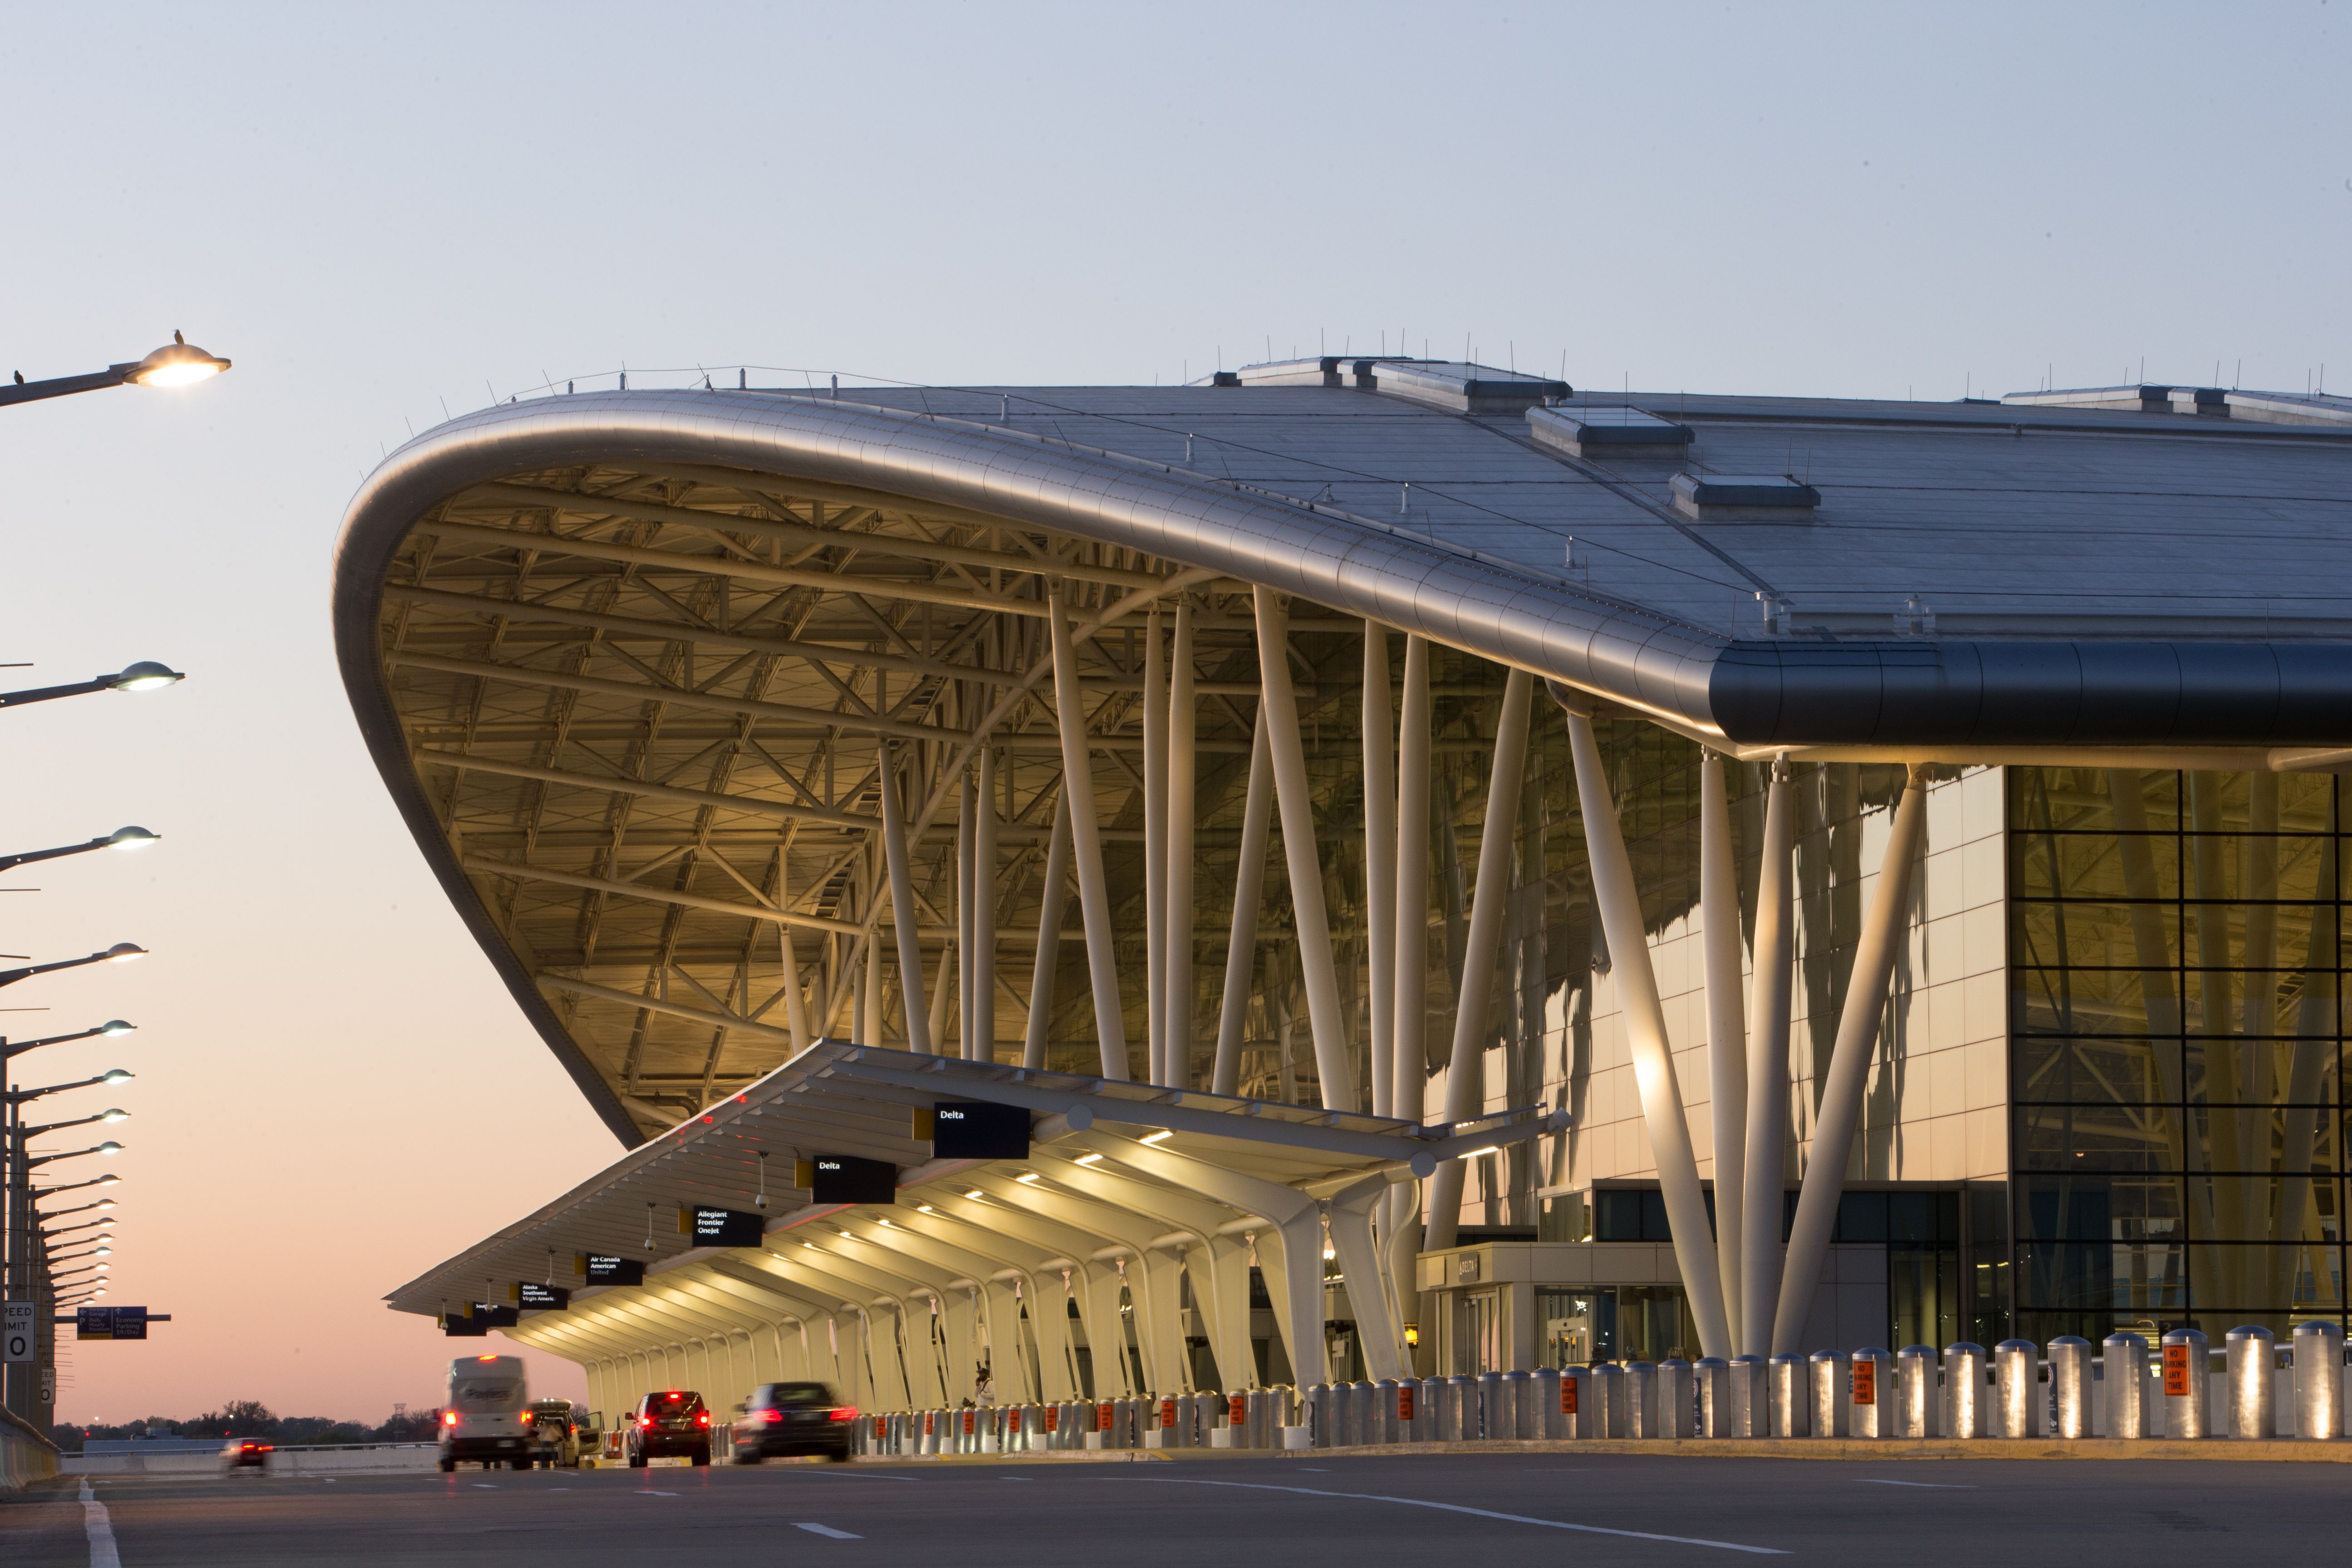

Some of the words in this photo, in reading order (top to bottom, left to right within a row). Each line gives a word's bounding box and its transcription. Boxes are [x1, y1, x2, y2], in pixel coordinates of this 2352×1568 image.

[941, 1111, 964, 1119] Delta
[1462, 1260, 1474, 1273] DELTA
[5, 1308, 32, 1316] PEED
[5, 1322, 27, 1331] IMIT
